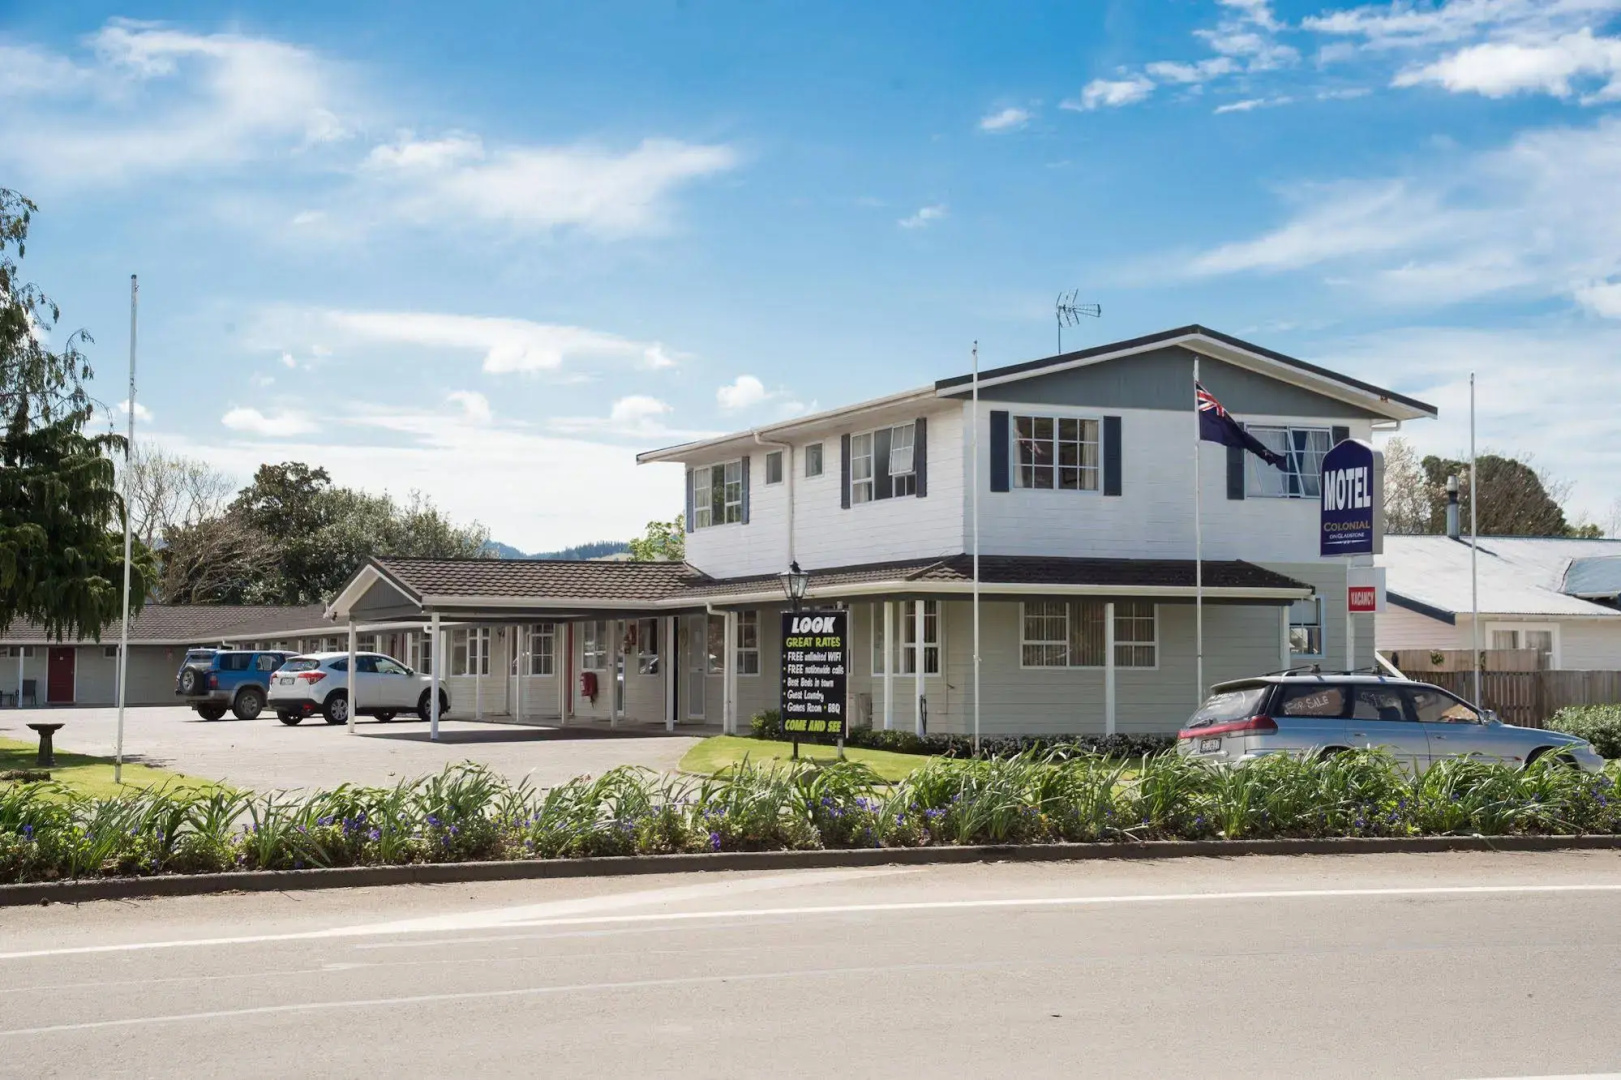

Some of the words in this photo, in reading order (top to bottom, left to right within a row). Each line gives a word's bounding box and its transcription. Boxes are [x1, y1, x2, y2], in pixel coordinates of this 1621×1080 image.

[1324, 466, 1371, 511] MOTEL
[1323, 521, 1370, 532] COLONIAL
[1351, 591, 1374, 606] VACANCY
[791, 616, 837, 634] LOOK
[786, 636, 813, 648] GREAT
[815, 636, 841, 648] RATES
[787, 651, 804, 662] FREE
[804, 651, 827, 662] unlimited
[827, 651, 842, 662] WIFI
[787, 664, 804, 674] FREE
[804, 664, 831, 674] nationwide
[831, 664, 844, 675] calls
[787, 677, 799, 687] Best
[800, 677, 813, 687] Beds
[814, 677, 820, 687] in
[820, 678, 834, 688] town
[787, 689, 803, 700] Guest
[803, 689, 825, 703] Laundry
[1306, 695, 1330, 709] SALE
[787, 702, 806, 712] Games
[806, 702, 822, 713] Room
[827, 702, 841, 715] BBQ
[784, 719, 808, 731] COME
[807, 719, 827, 732] AND
[827, 720, 842, 733] SEE
